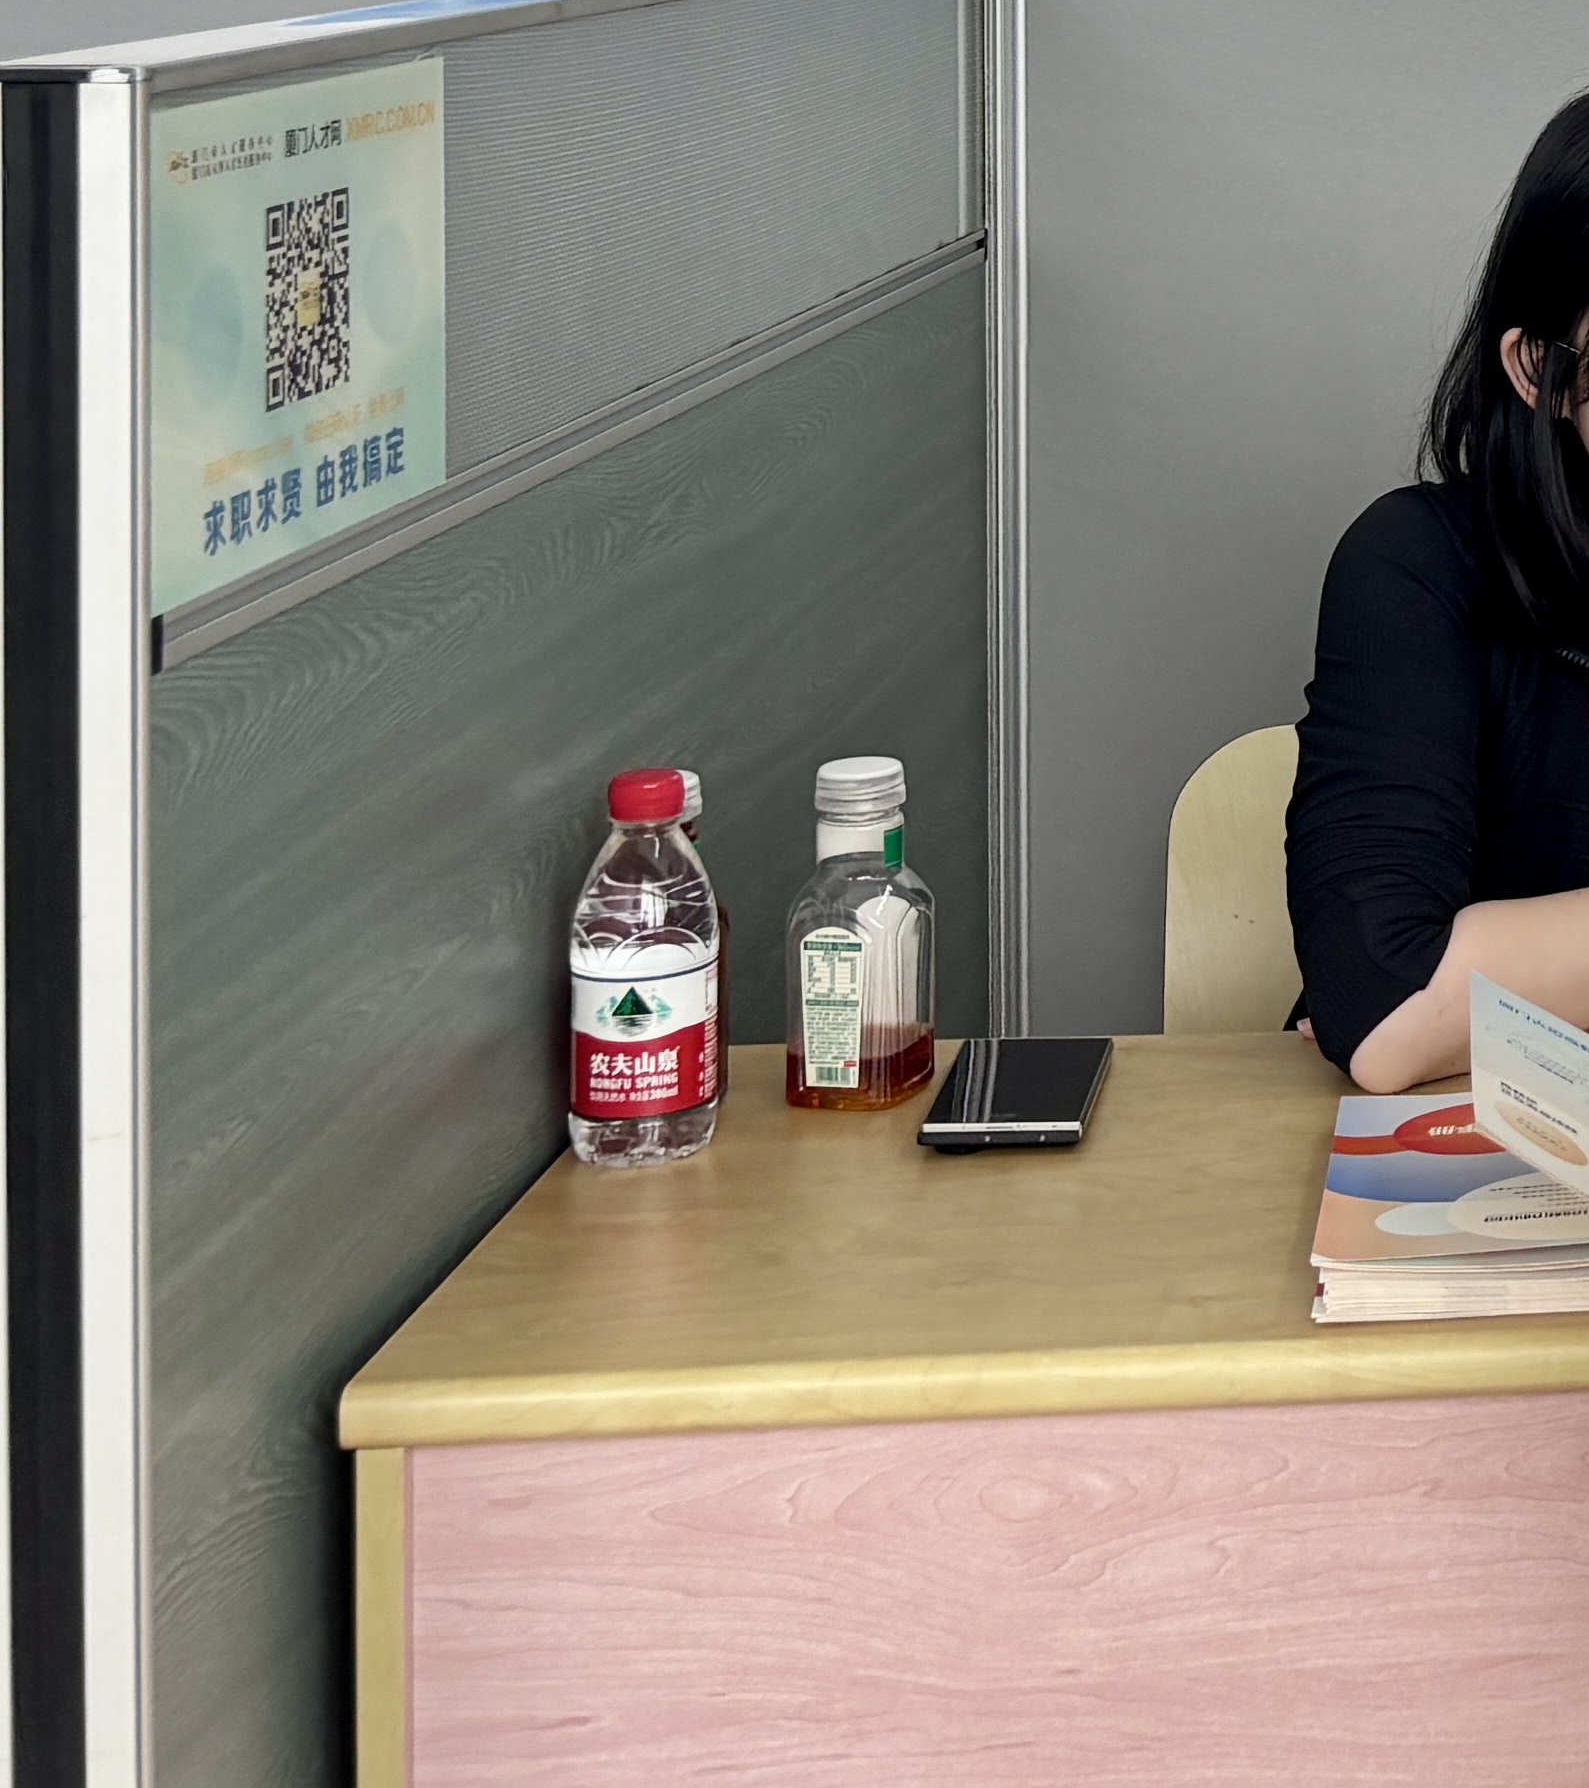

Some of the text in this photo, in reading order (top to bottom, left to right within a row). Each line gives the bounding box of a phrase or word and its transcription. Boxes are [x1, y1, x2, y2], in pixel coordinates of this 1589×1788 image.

[203, 467, 303, 557] 求职求贤
[316, 426, 405, 508] 由我搞定
[590, 1048, 680, 1076] 农夫山泉
